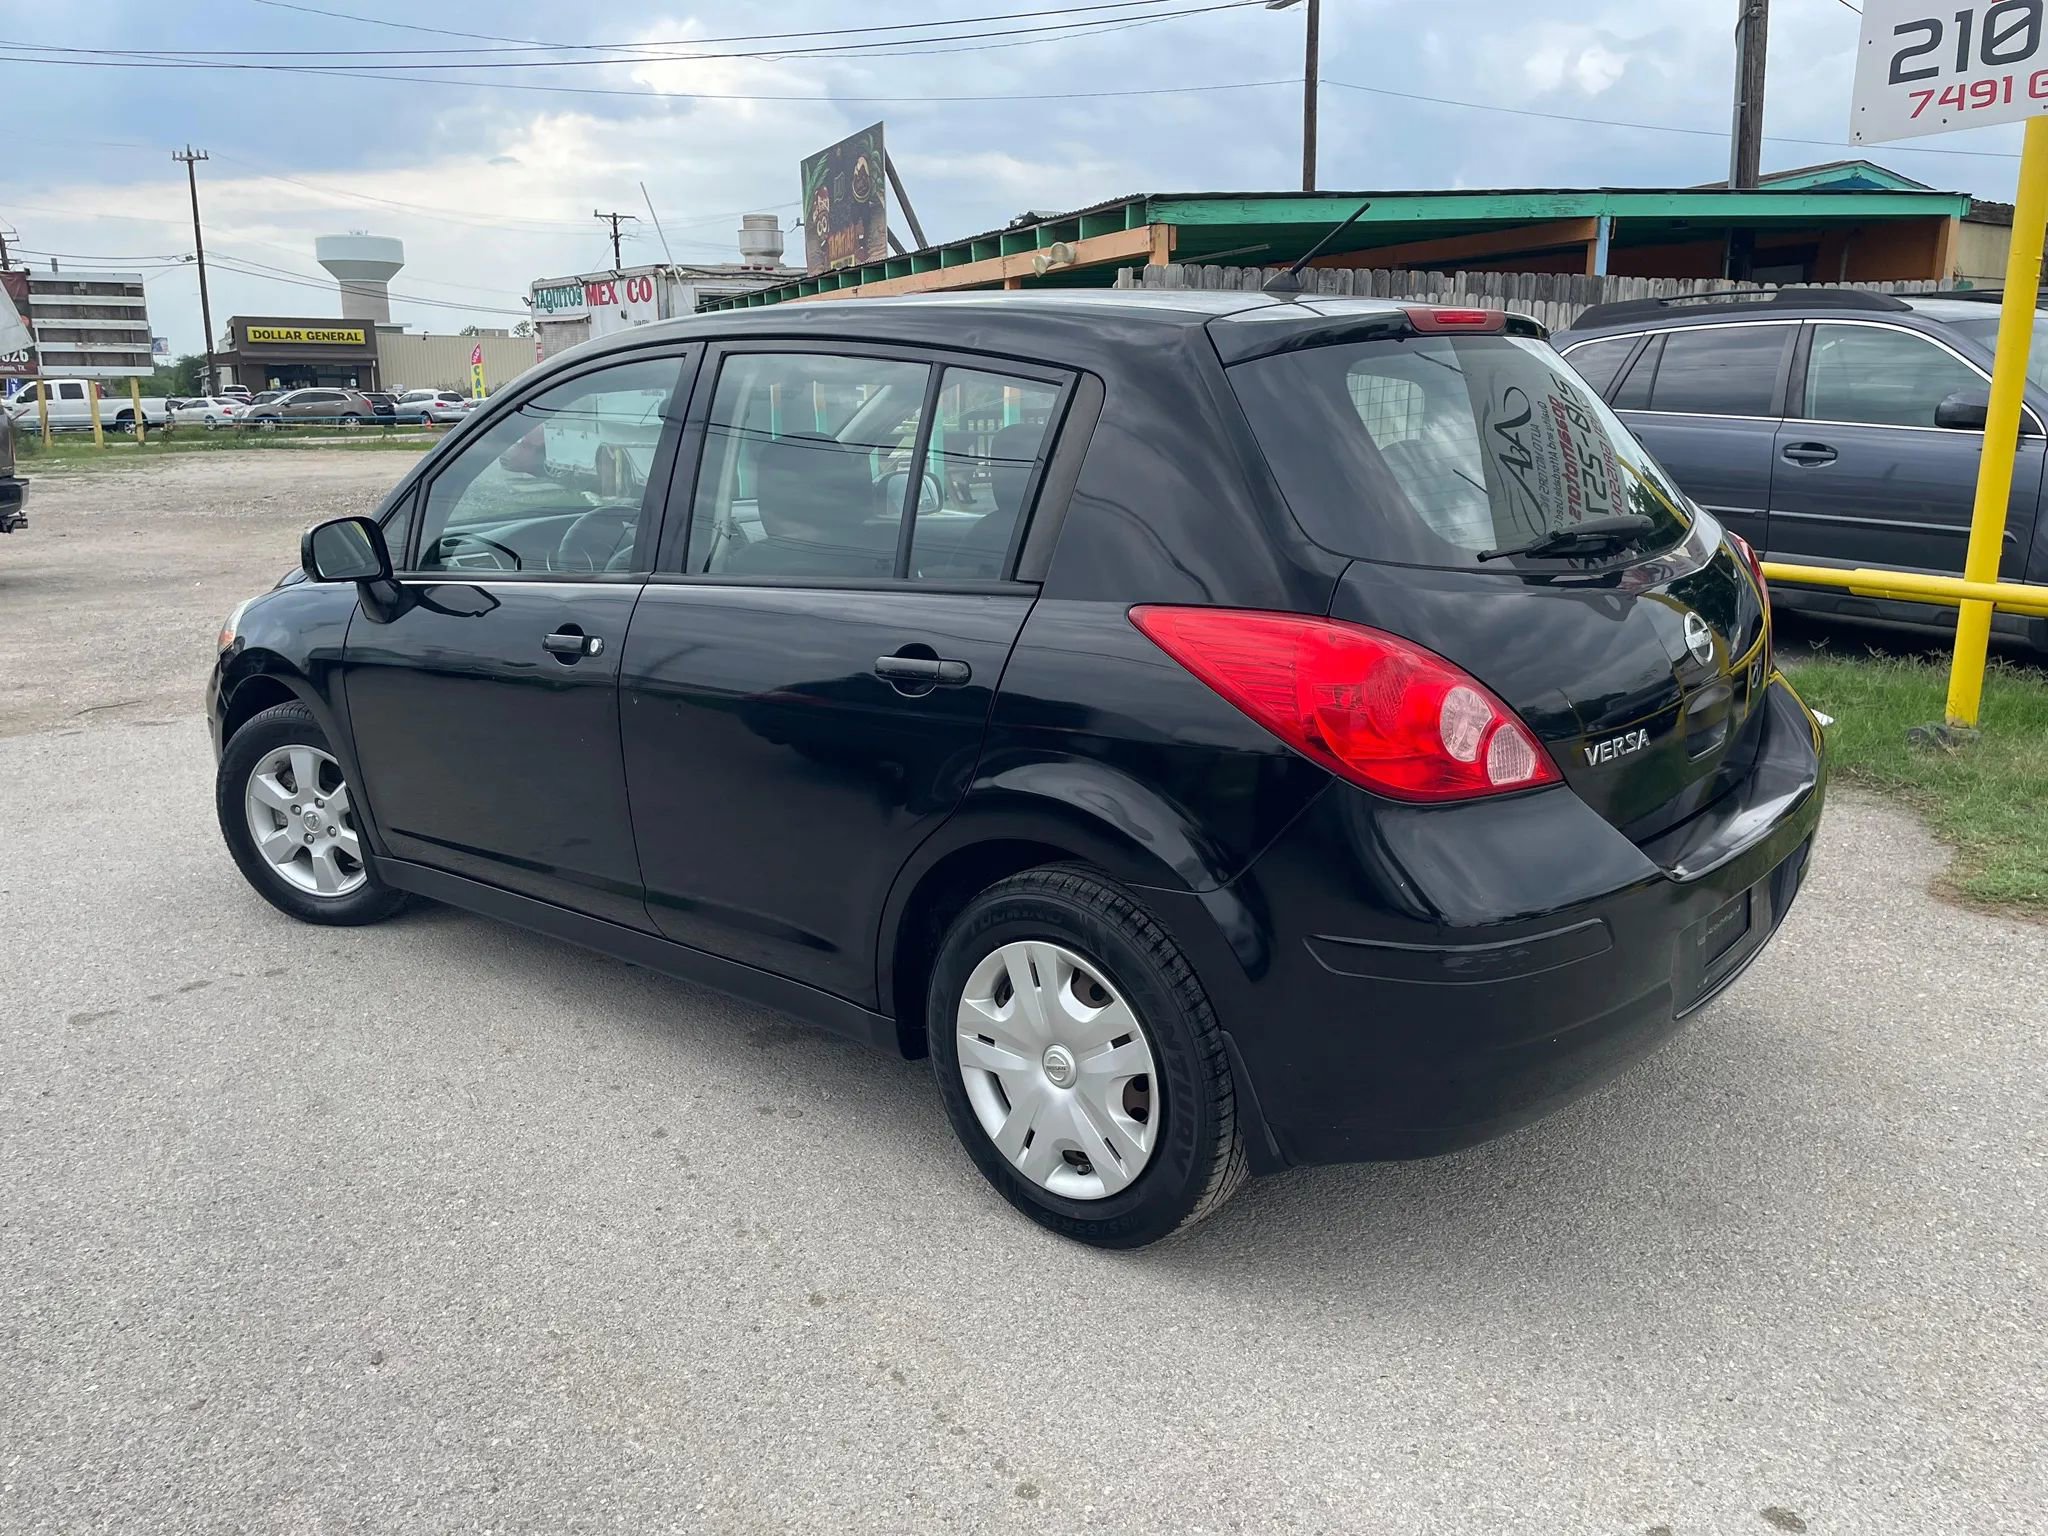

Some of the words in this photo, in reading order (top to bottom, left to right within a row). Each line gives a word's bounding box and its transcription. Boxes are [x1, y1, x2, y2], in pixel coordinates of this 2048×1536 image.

[1888, 0, 2043, 85] 210
[1908, 75, 2013, 119] 7491
[252, 329, 302, 341] DOLLAR
[306, 330, 361, 342] GENERAL
[1583, 728, 1651, 767] VERSA
